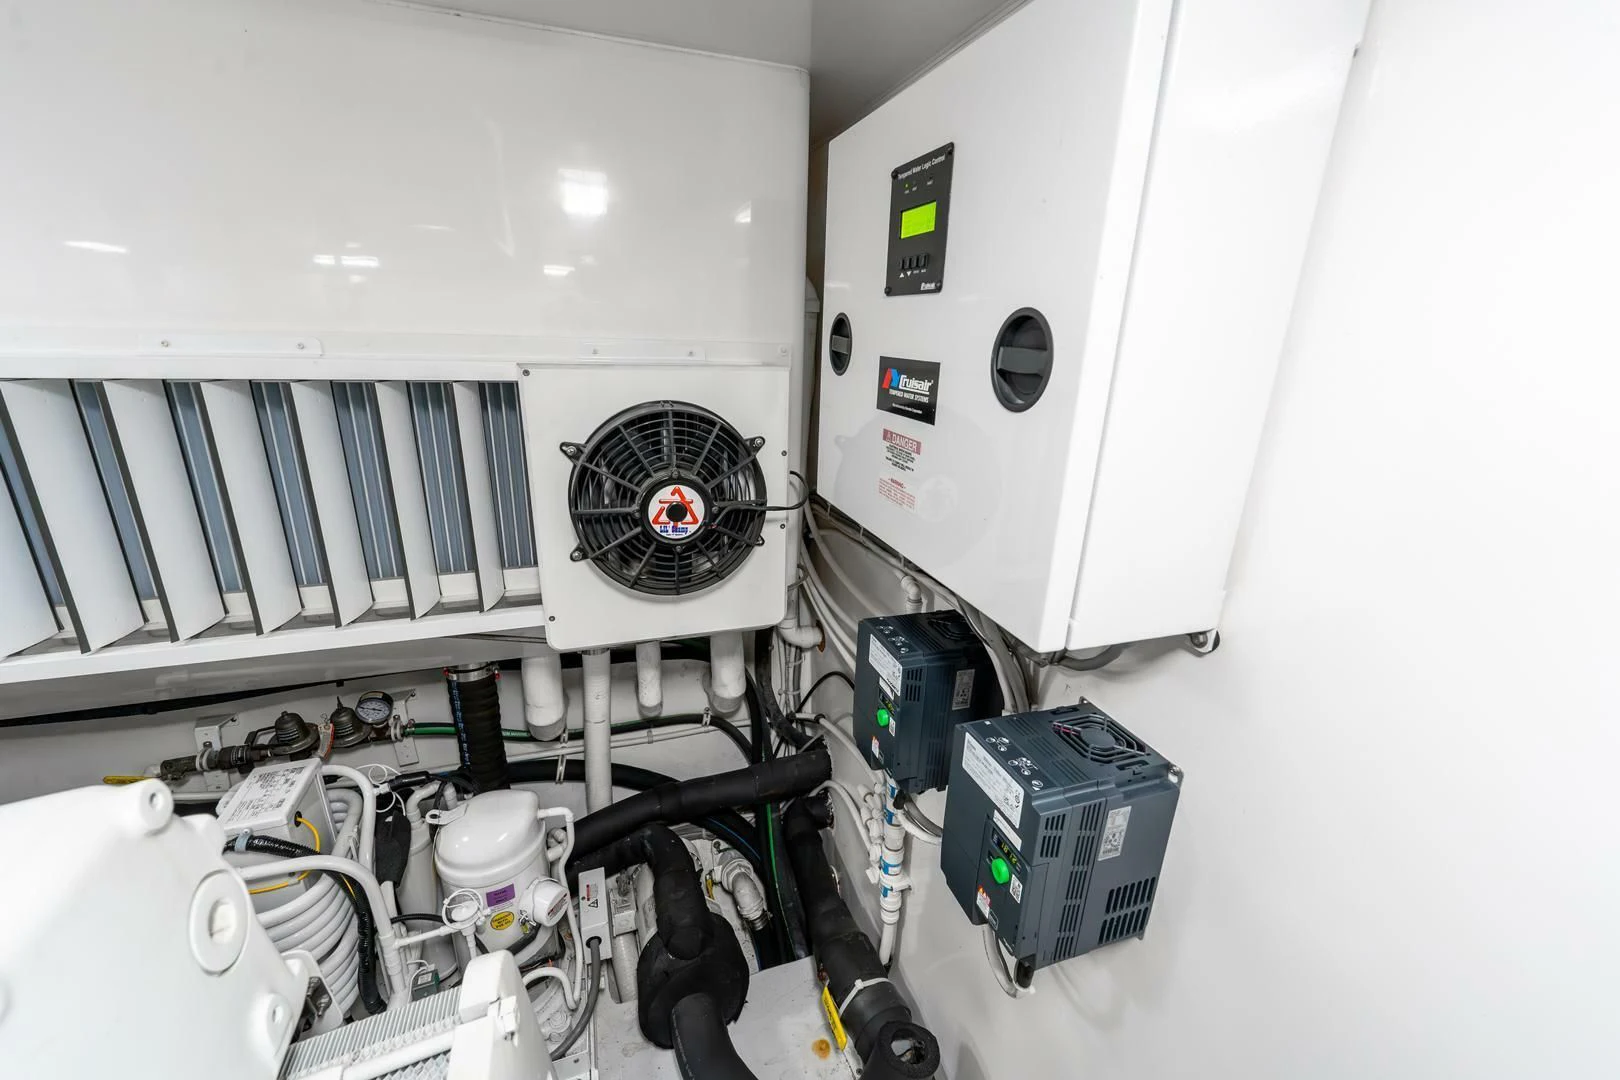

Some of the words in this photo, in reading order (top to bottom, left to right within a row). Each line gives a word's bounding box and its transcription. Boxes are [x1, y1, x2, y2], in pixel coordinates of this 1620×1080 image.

[912, 165, 921, 174] Water
[922, 160, 931, 170] Logic
[931, 153, 945, 166] Control
[899, 374, 933, 394] Cruisair
[904, 391, 914, 400] WATER
[914, 394, 929, 403] SYSTEMS
[892, 433, 918, 452] DANGER
